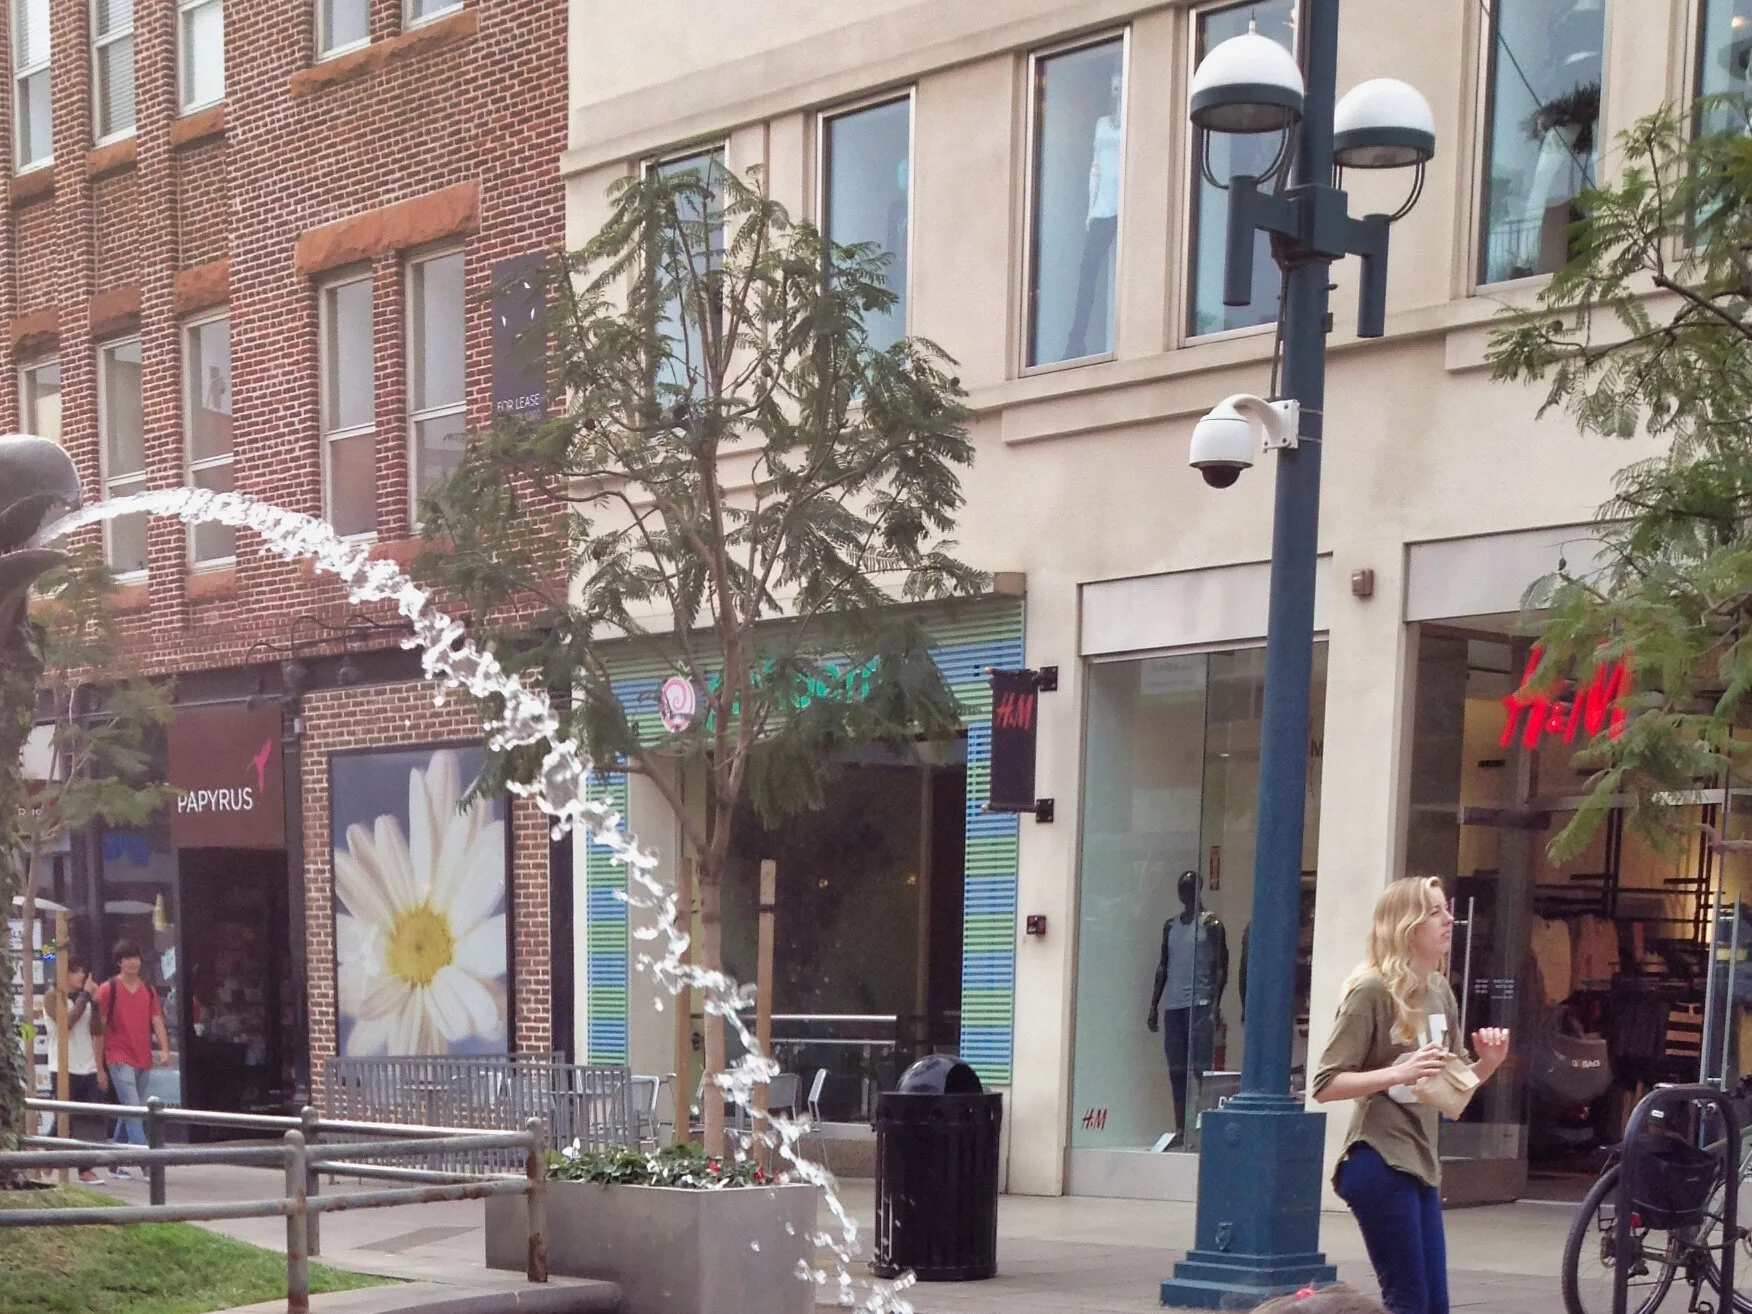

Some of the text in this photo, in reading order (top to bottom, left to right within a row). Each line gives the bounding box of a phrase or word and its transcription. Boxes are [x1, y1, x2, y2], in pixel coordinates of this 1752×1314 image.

[497, 393, 540, 411] FOR LEASE
[178, 787, 254, 814] PAPYRUS
[1082, 1108, 1107, 1131] H&M
